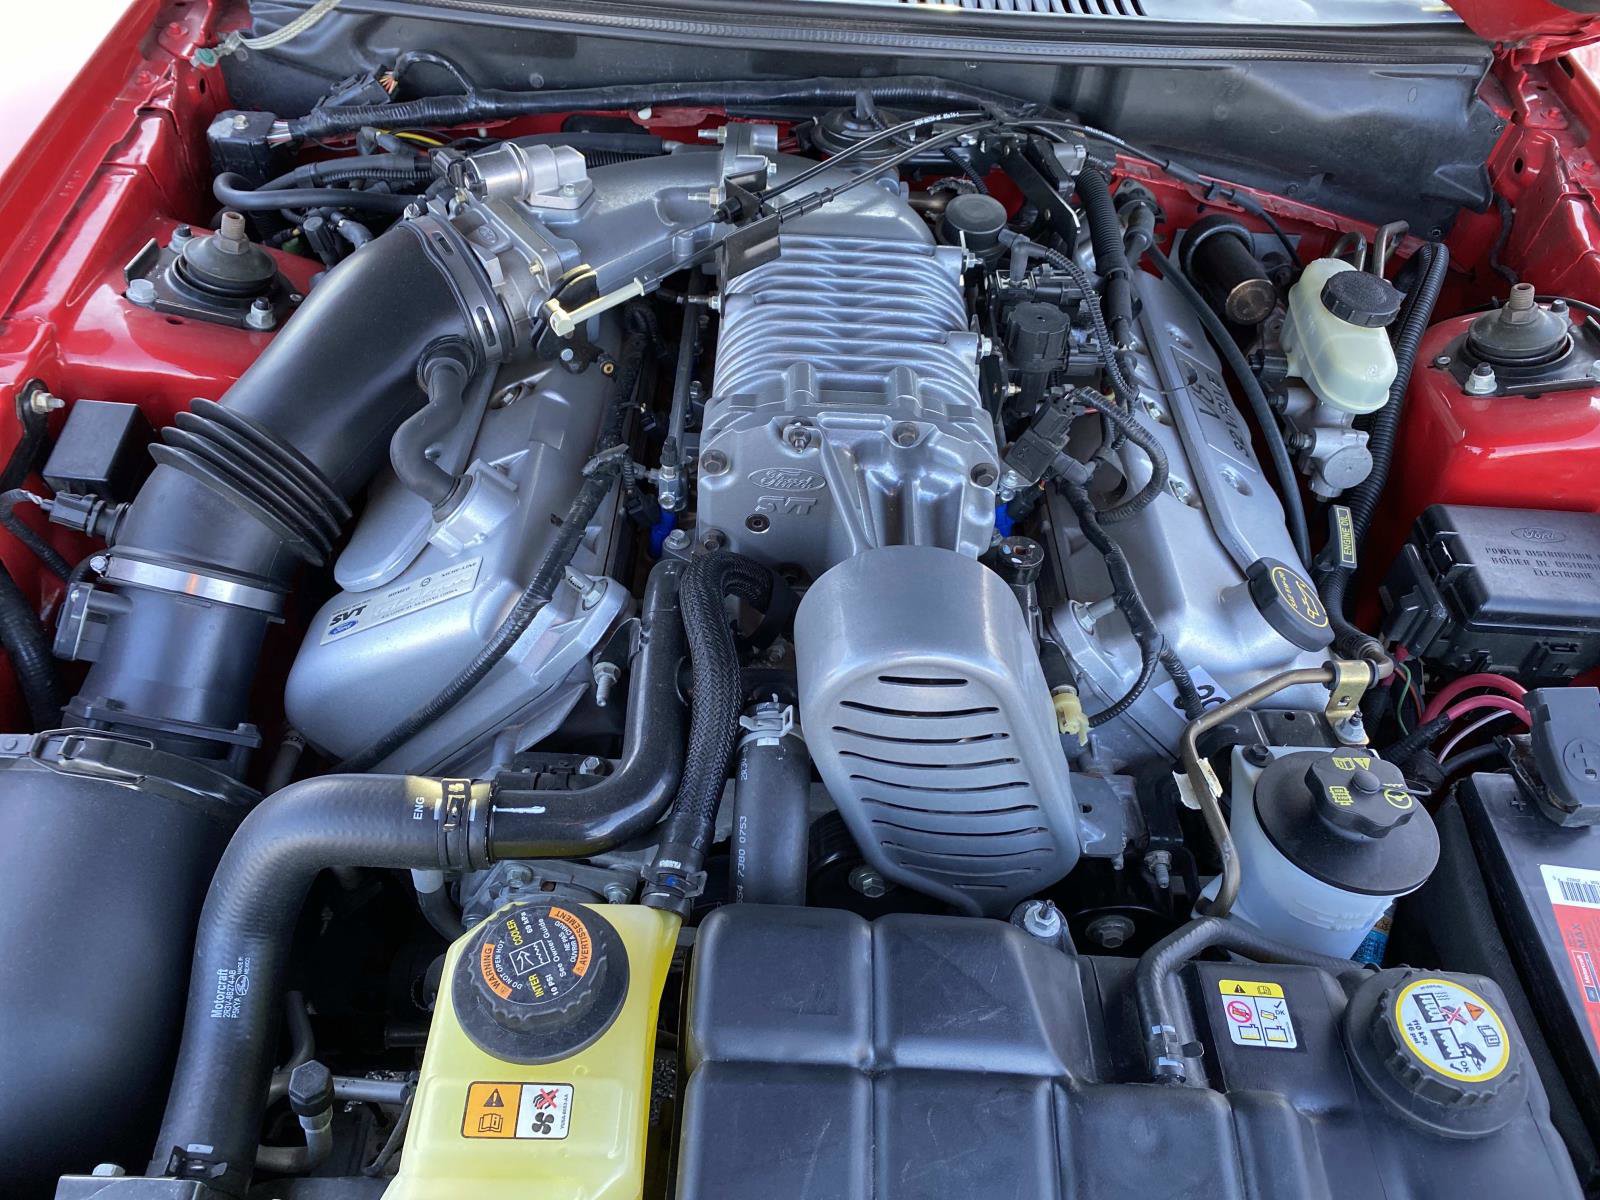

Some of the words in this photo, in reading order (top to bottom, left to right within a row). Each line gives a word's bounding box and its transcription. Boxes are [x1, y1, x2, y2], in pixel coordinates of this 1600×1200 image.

[759, 469, 816, 489] Ford
[755, 495, 818, 515] SVT
[1341, 526, 1352, 556] ENGINE
[329, 605, 368, 627] SVT
[413, 796, 425, 820] ENG
[506, 920, 524, 946] COOLER
[525, 924, 534, 934] 69
[538, 918, 550, 939] Guide
[556, 910, 589, 966] AVERTISSEMENT
[496, 940, 506, 954] HOT
[548, 940, 560, 962] Owner
[484, 948, 501, 990] WARNING
[494, 956, 504, 972] OPEN
[558, 963, 566, 978] See
[500, 973, 512, 984] NOT
[512, 981, 523, 990] DO
[528, 974, 544, 998] INTER
[545, 974, 556, 987] PSI
[211, 968, 228, 1018] Motorcraft
[551, 986, 559, 996] 10
[1460, 1060, 1471, 1073] OK
